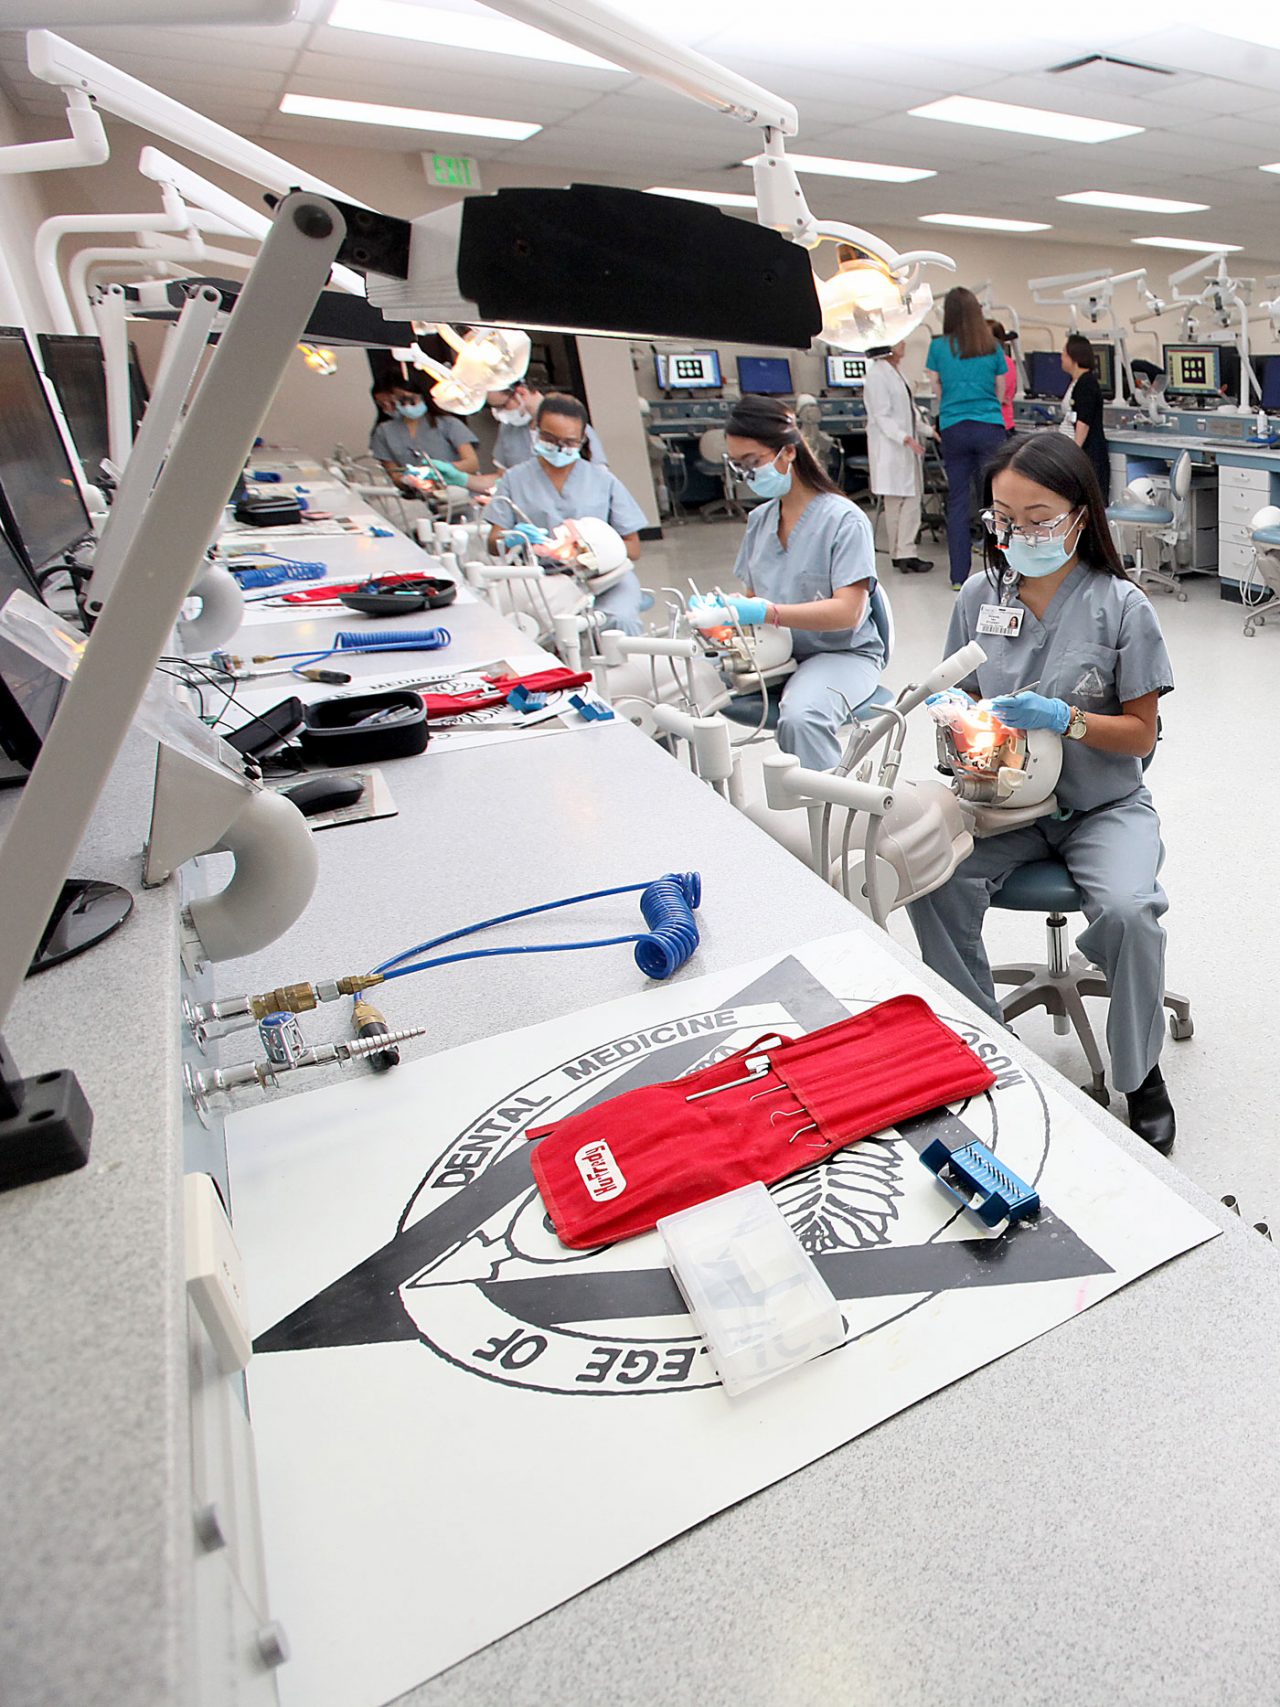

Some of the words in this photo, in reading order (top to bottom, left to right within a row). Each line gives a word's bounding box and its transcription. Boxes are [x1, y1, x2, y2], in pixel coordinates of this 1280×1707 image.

[431, 154, 472, 187] EXIT
[562, 1010, 738, 1081] MEDICINE
[430, 1095, 552, 1189] DENTAL
[472, 1328, 548, 1370] OF
